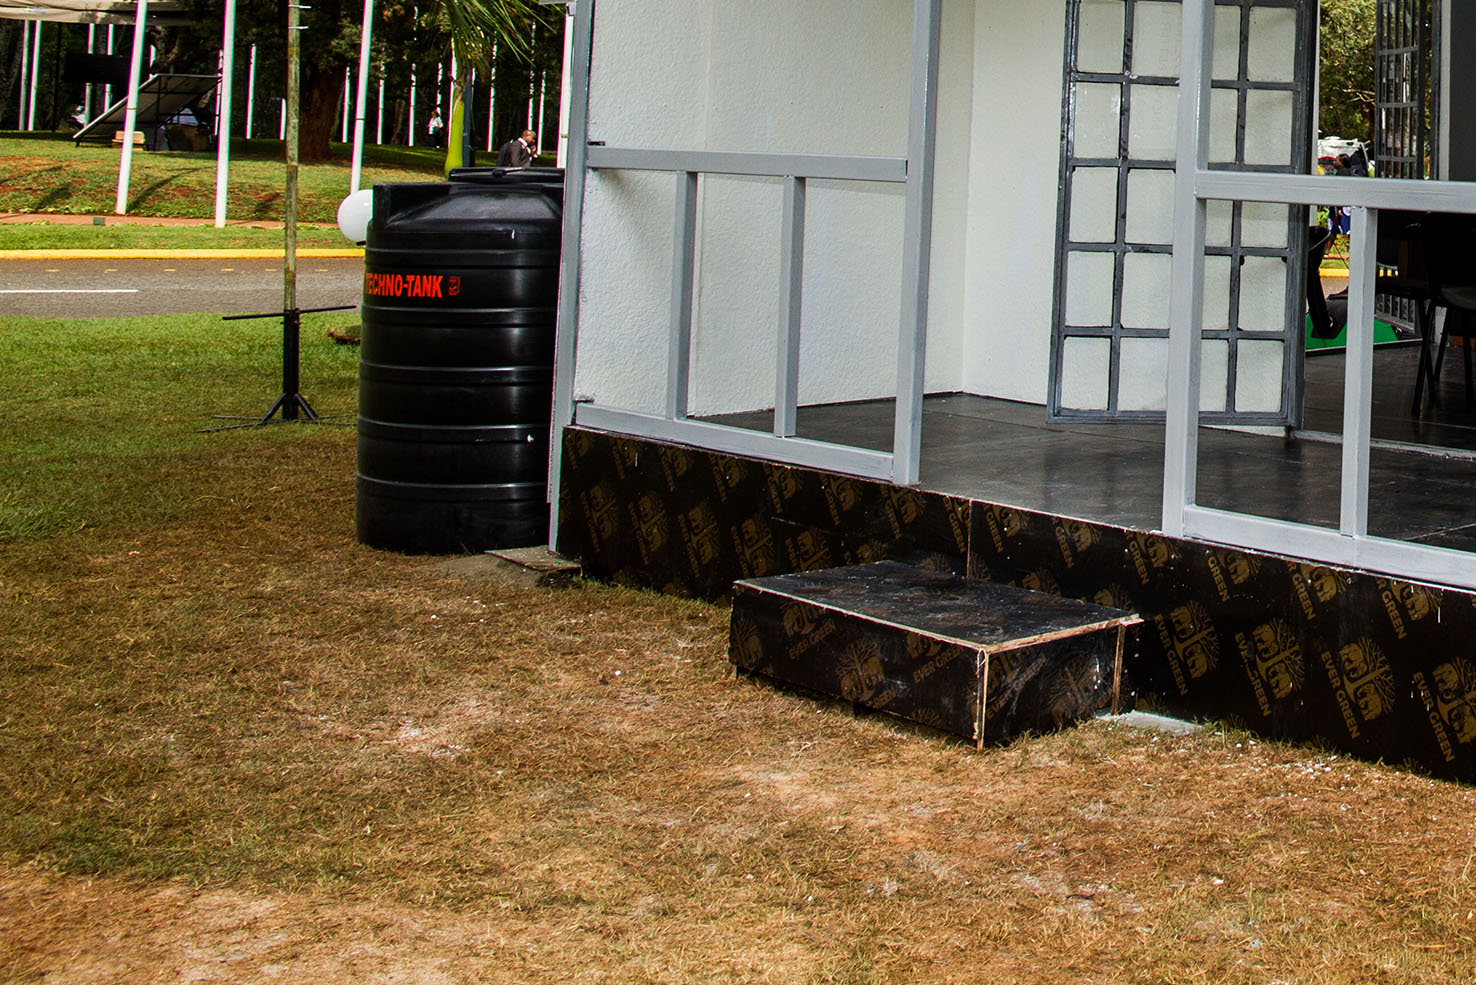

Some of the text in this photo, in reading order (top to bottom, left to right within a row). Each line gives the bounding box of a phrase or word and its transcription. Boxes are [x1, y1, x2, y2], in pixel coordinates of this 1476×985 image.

[366, 273, 443, 298] TECHNO-TANK
[950, 512, 967, 553] GREEN
[985, 512, 1005, 554] GREEN
[1056, 525, 1075, 569] GREEN
[1128, 540, 1150, 584] GREEN
[1206, 557, 1230, 604] GREEN
[1291, 573, 1316, 619] GREEN
[1382, 590, 1407, 640] GREEN
[912, 660, 937, 684] EVER
[1154, 613, 1190, 696] EVER GREEN
[1248, 669, 1272, 716] GREEN
[1320, 650, 1361, 739] EVER GREEN
[1412, 672, 1456, 764] EVER GREEN
